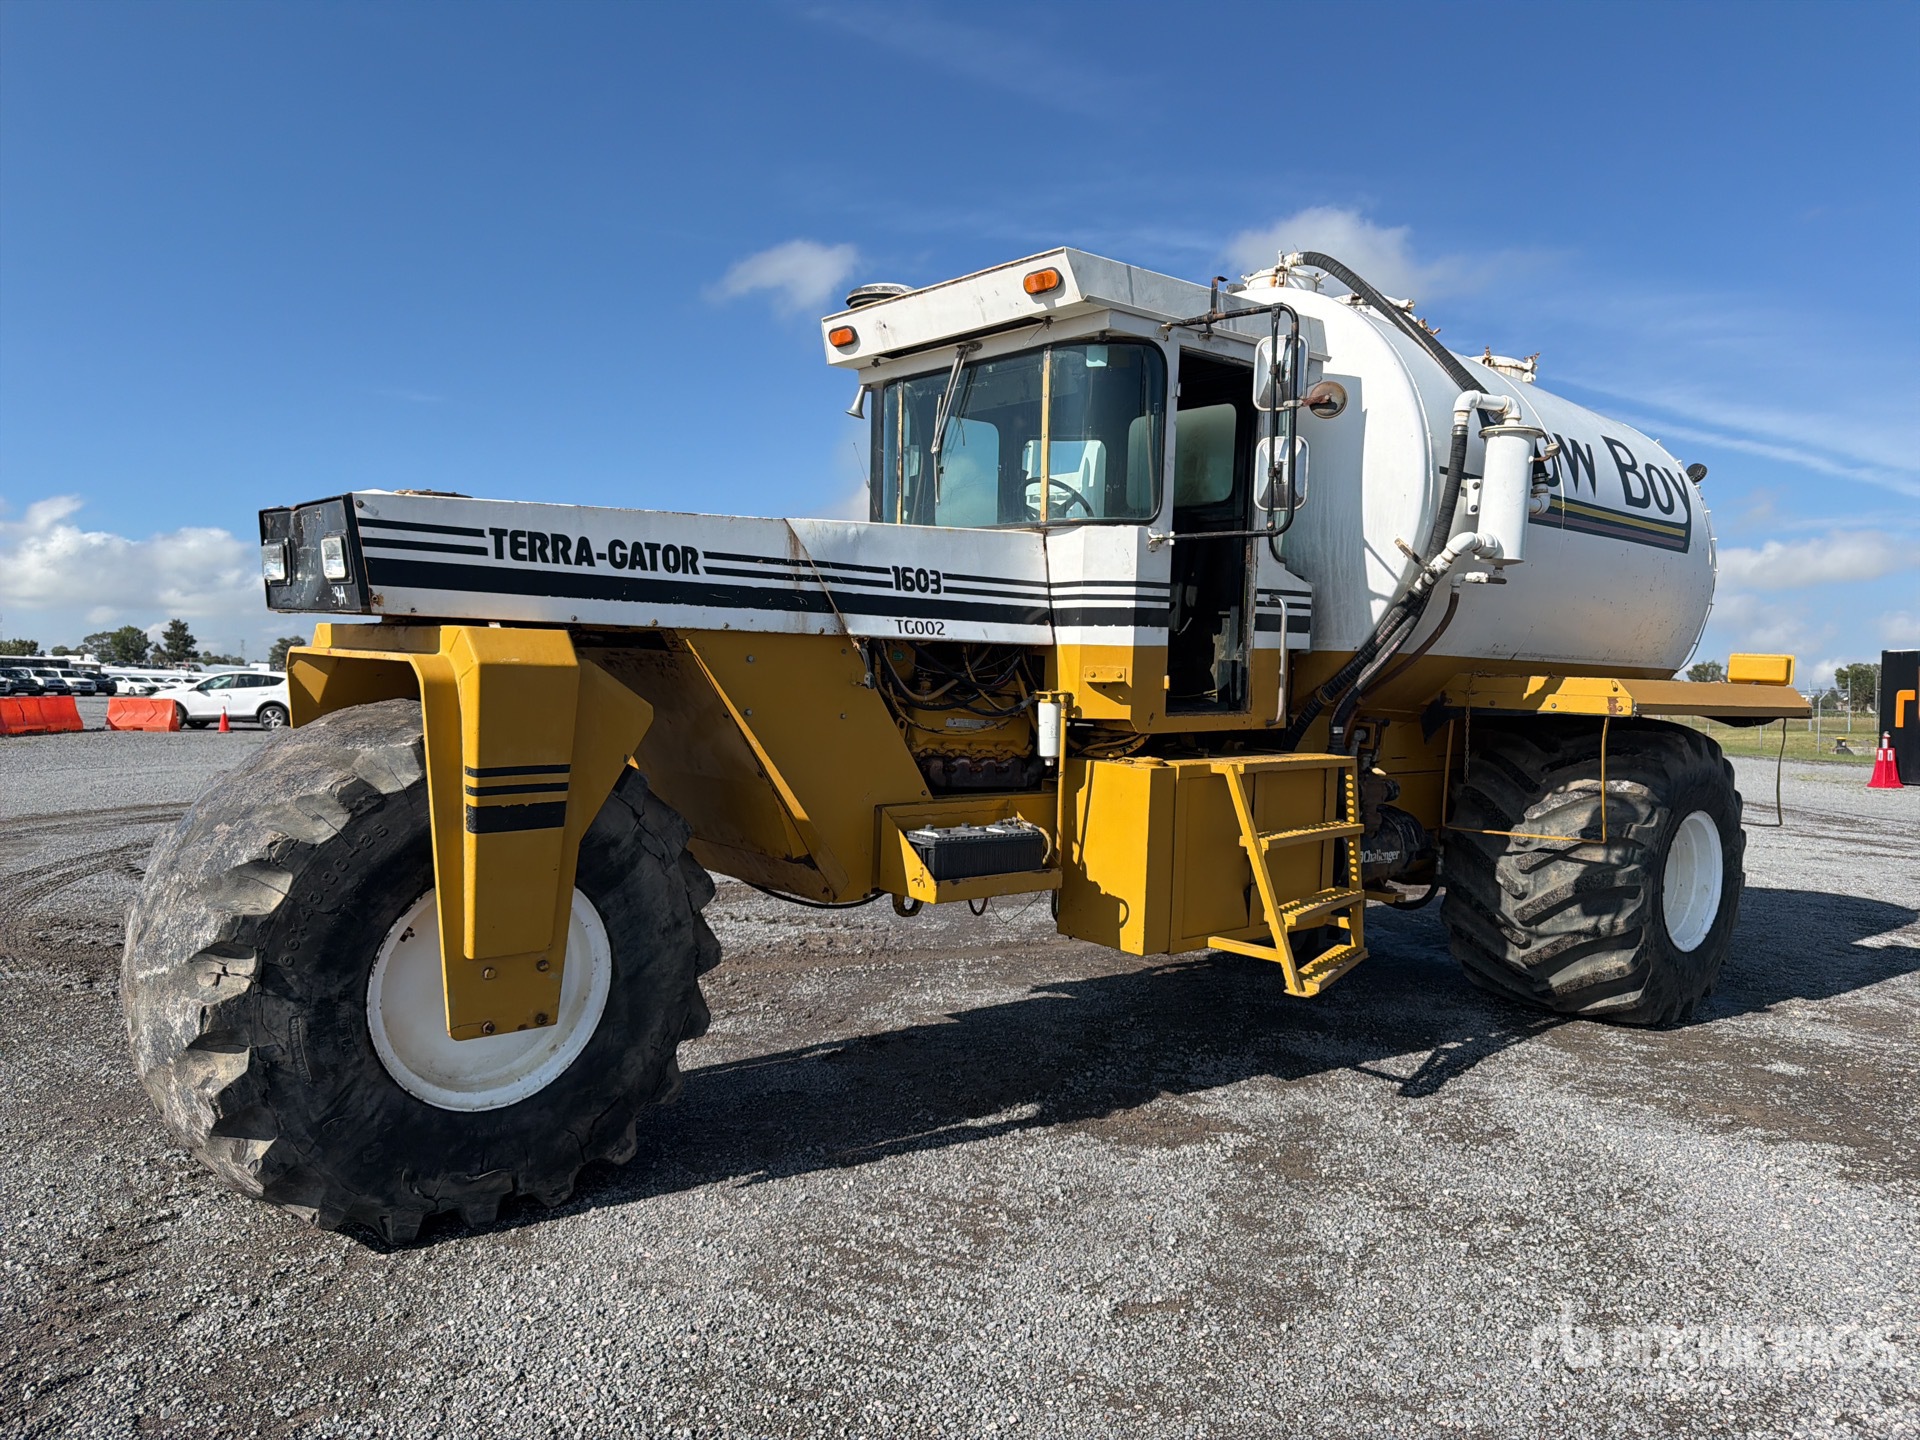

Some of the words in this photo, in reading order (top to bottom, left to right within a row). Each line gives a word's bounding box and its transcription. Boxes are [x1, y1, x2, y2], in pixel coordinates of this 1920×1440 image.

[488, 526, 700, 575] TERRA-GATOR
[891, 565, 943, 594] 1603
[894, 618, 946, 636] TG002
